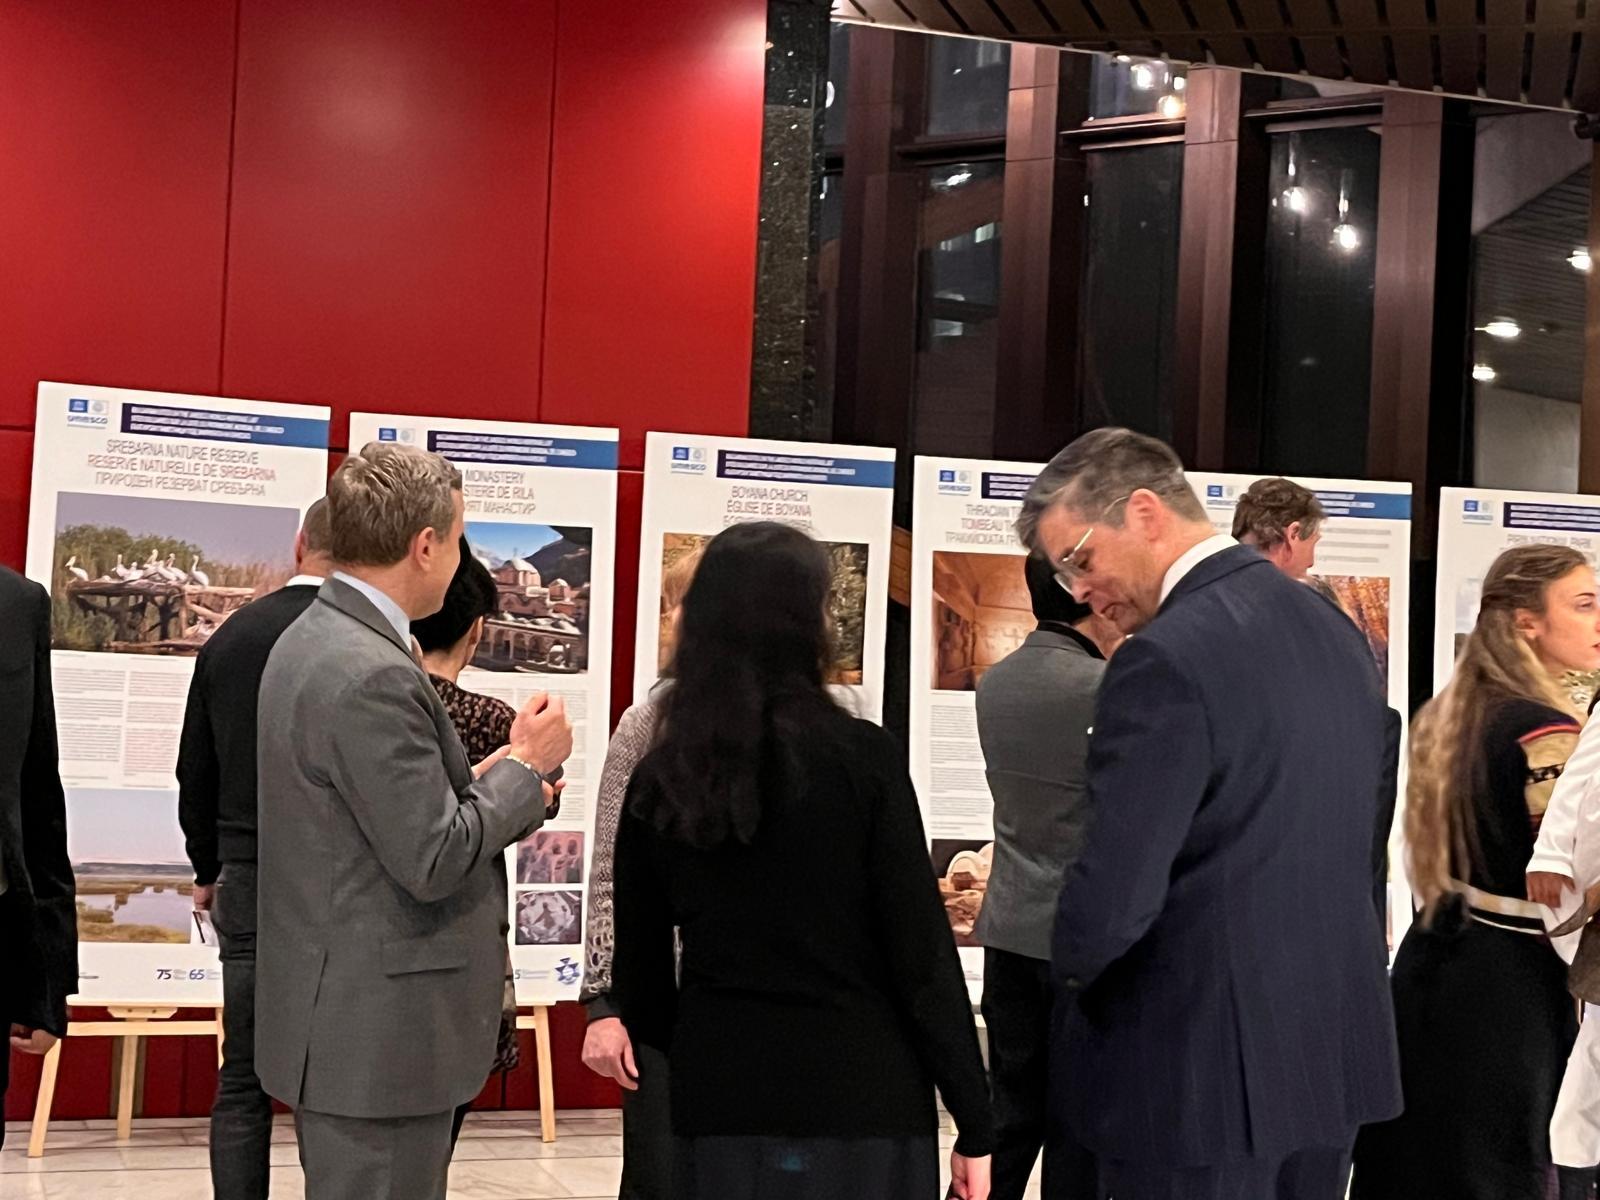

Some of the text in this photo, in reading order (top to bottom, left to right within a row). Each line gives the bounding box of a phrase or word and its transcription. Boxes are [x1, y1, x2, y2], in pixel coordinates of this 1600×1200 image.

[166, 444, 208, 461] NATURE
[210, 448, 259, 465] RESERVE
[141, 459, 201, 476] NATURELLE
[203, 463, 218, 478] DE
[465, 469, 526, 484] MONASTERY
[497, 486, 511, 499] DE
[760, 502, 774, 516] DE
[156, 968, 172, 980] 75
[189, 968, 205, 981] 65
